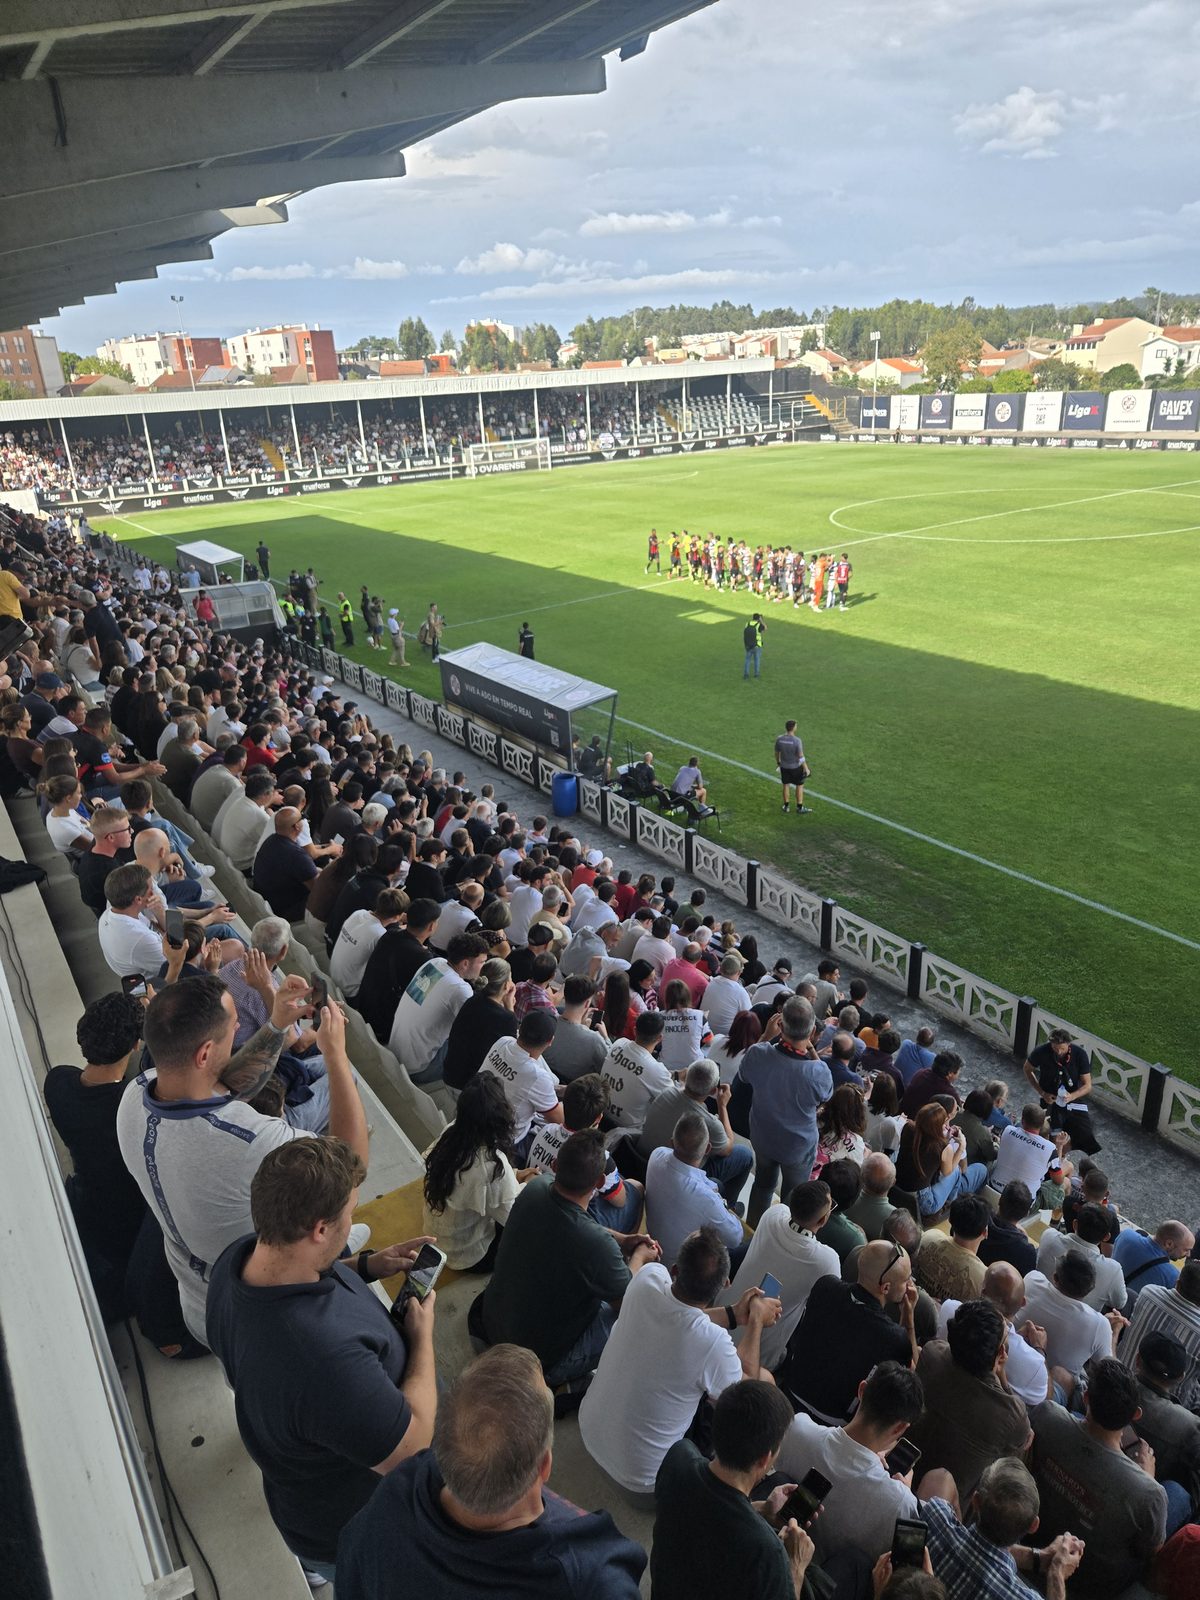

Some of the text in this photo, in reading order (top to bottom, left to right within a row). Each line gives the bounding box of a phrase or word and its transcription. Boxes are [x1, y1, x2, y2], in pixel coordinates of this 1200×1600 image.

[1160, 400, 1193, 416] GAVEX
[479, 461, 526, 473] OVARENSE
[465, 683, 476, 695] VIVE
[501, 698, 518, 712] TEMPO
[519, 706, 533, 719] REAL
[610, 1046, 644, 1076] Chaos
[543, 1130, 562, 1149] TRUEF
[1008, 1129, 1046, 1151] TRUEFORCE
